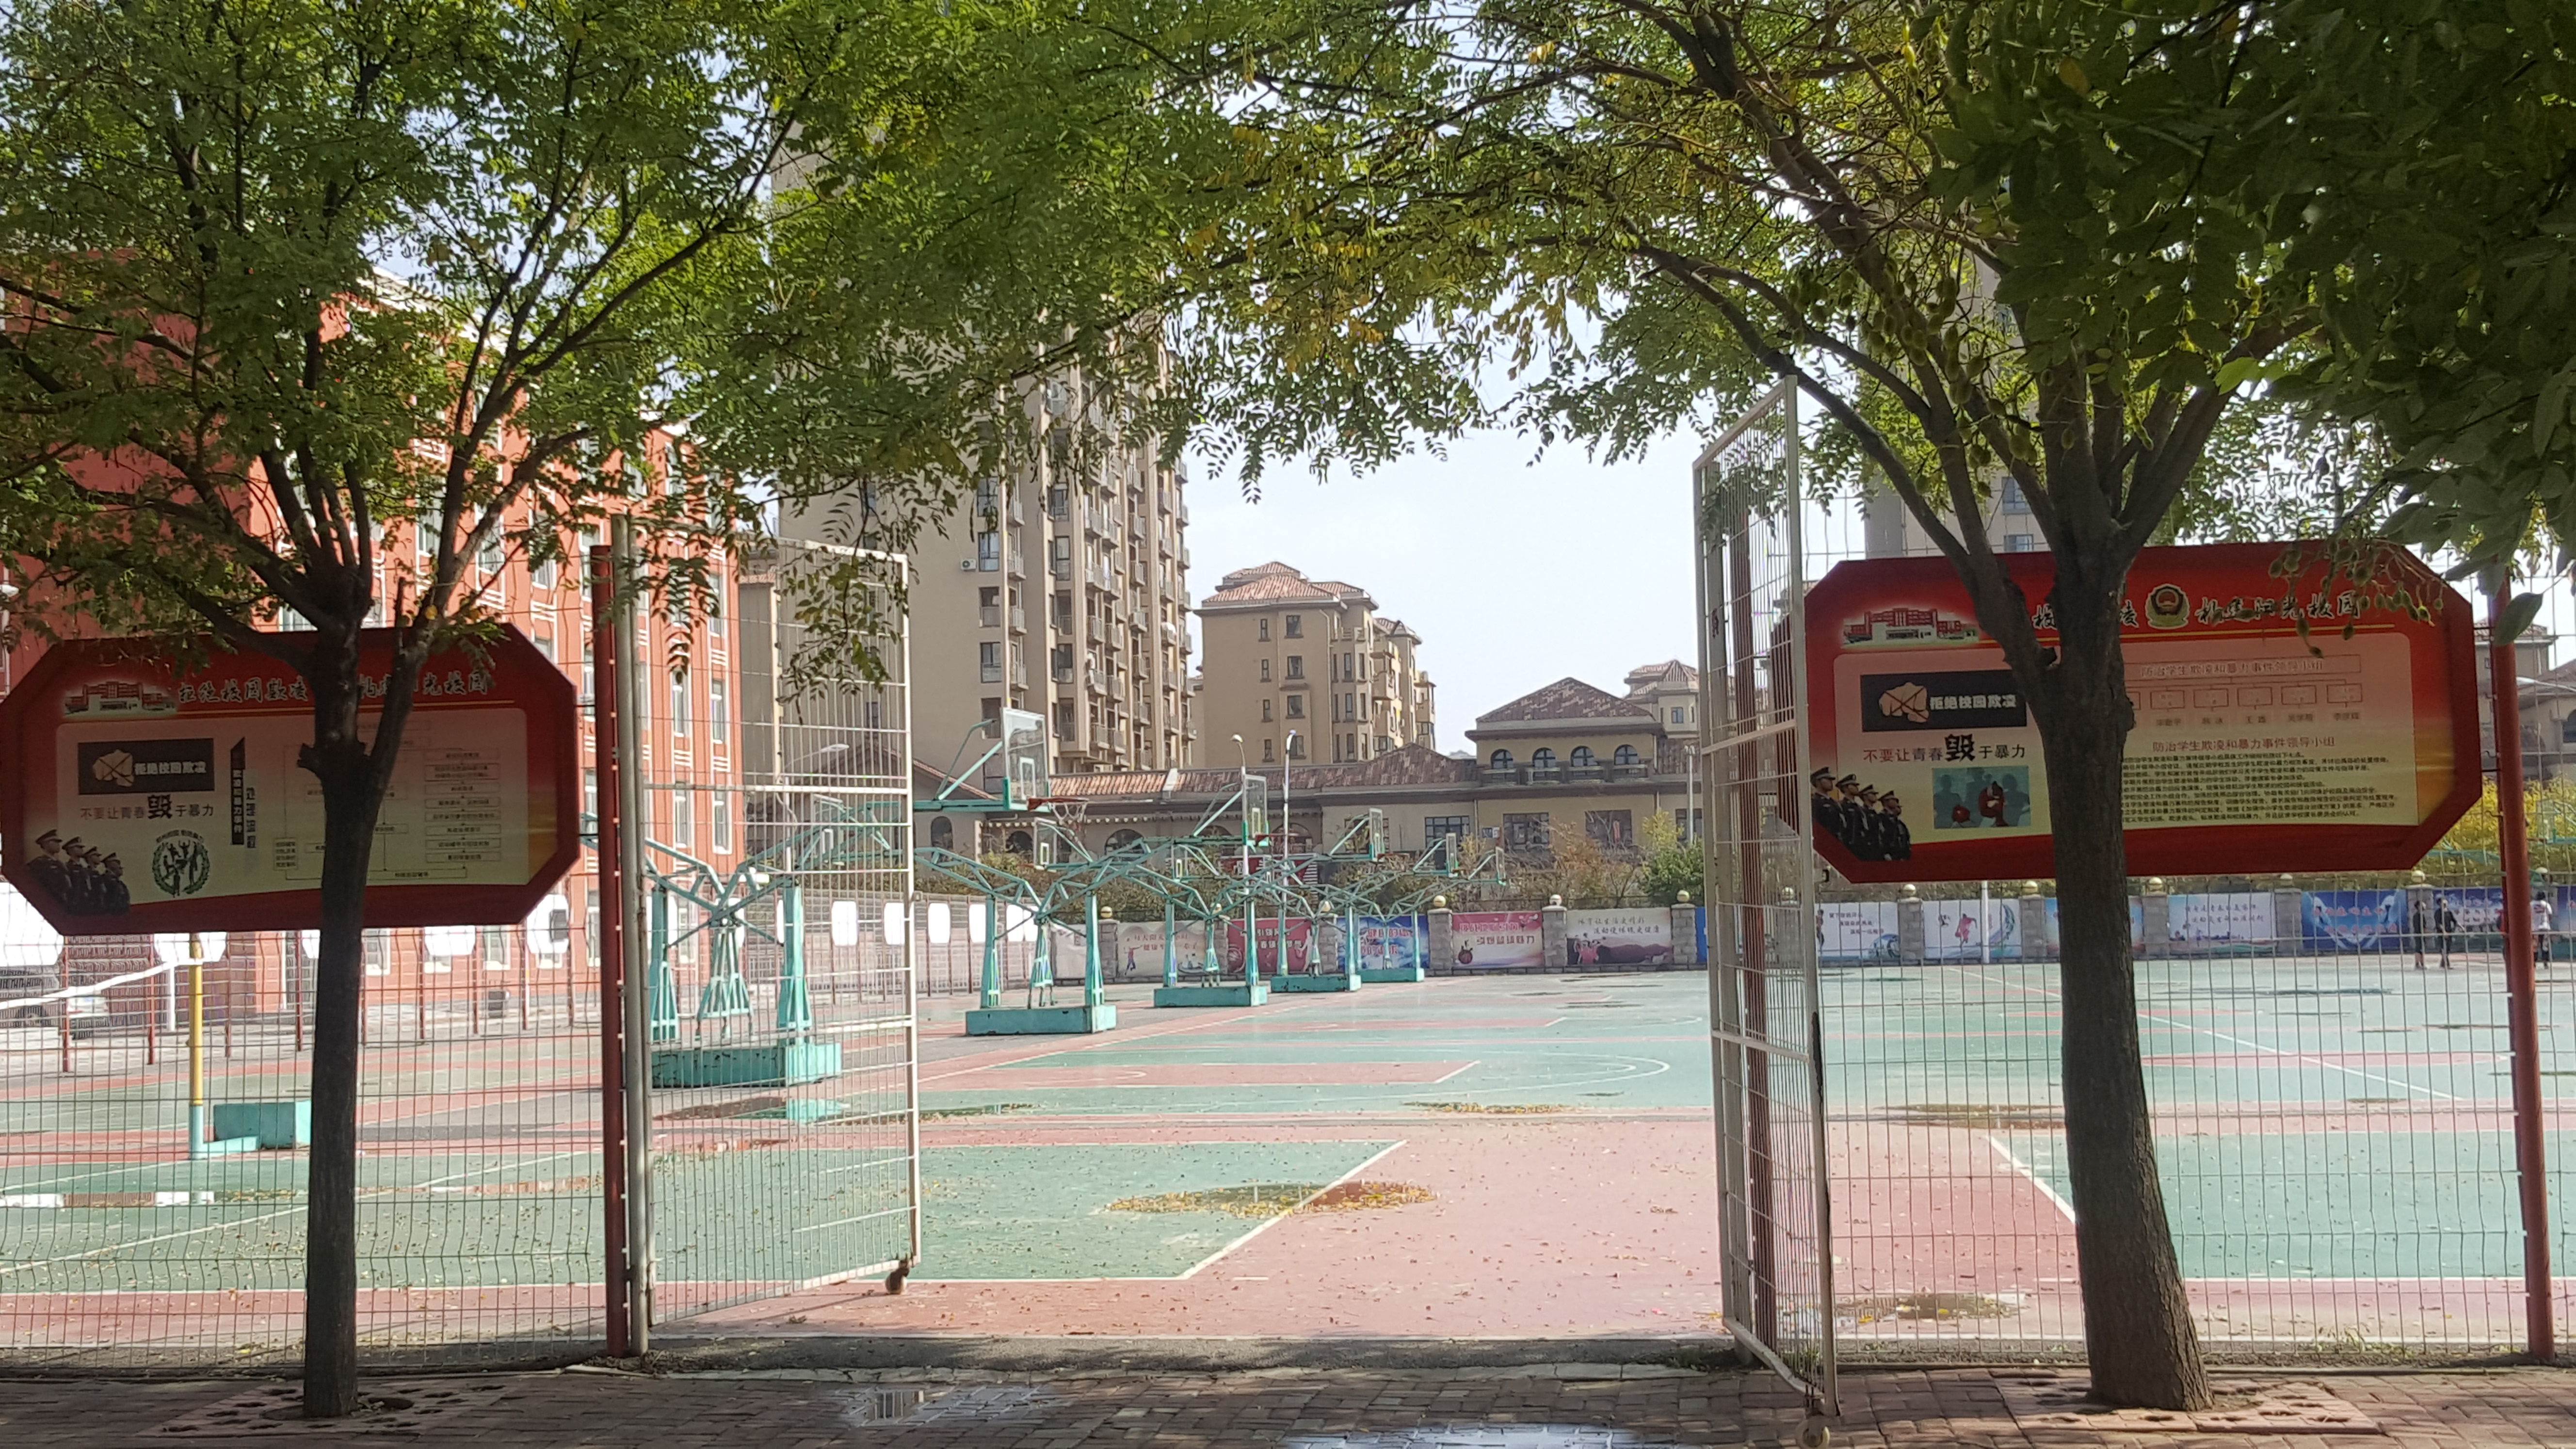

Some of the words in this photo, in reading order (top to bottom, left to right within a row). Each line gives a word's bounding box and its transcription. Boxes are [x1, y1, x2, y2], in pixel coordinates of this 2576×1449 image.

[178, 676, 308, 703] 拒绝校园欺凌
[1929, 694, 2017, 710] 拒绝校园欺凌
[1863, 733, 2026, 763] 不要让青春毁于暴力
[134, 761, 206, 776] 拒绝校园欺凌
[80, 794, 214, 820] 不要让青春毁于暴力
